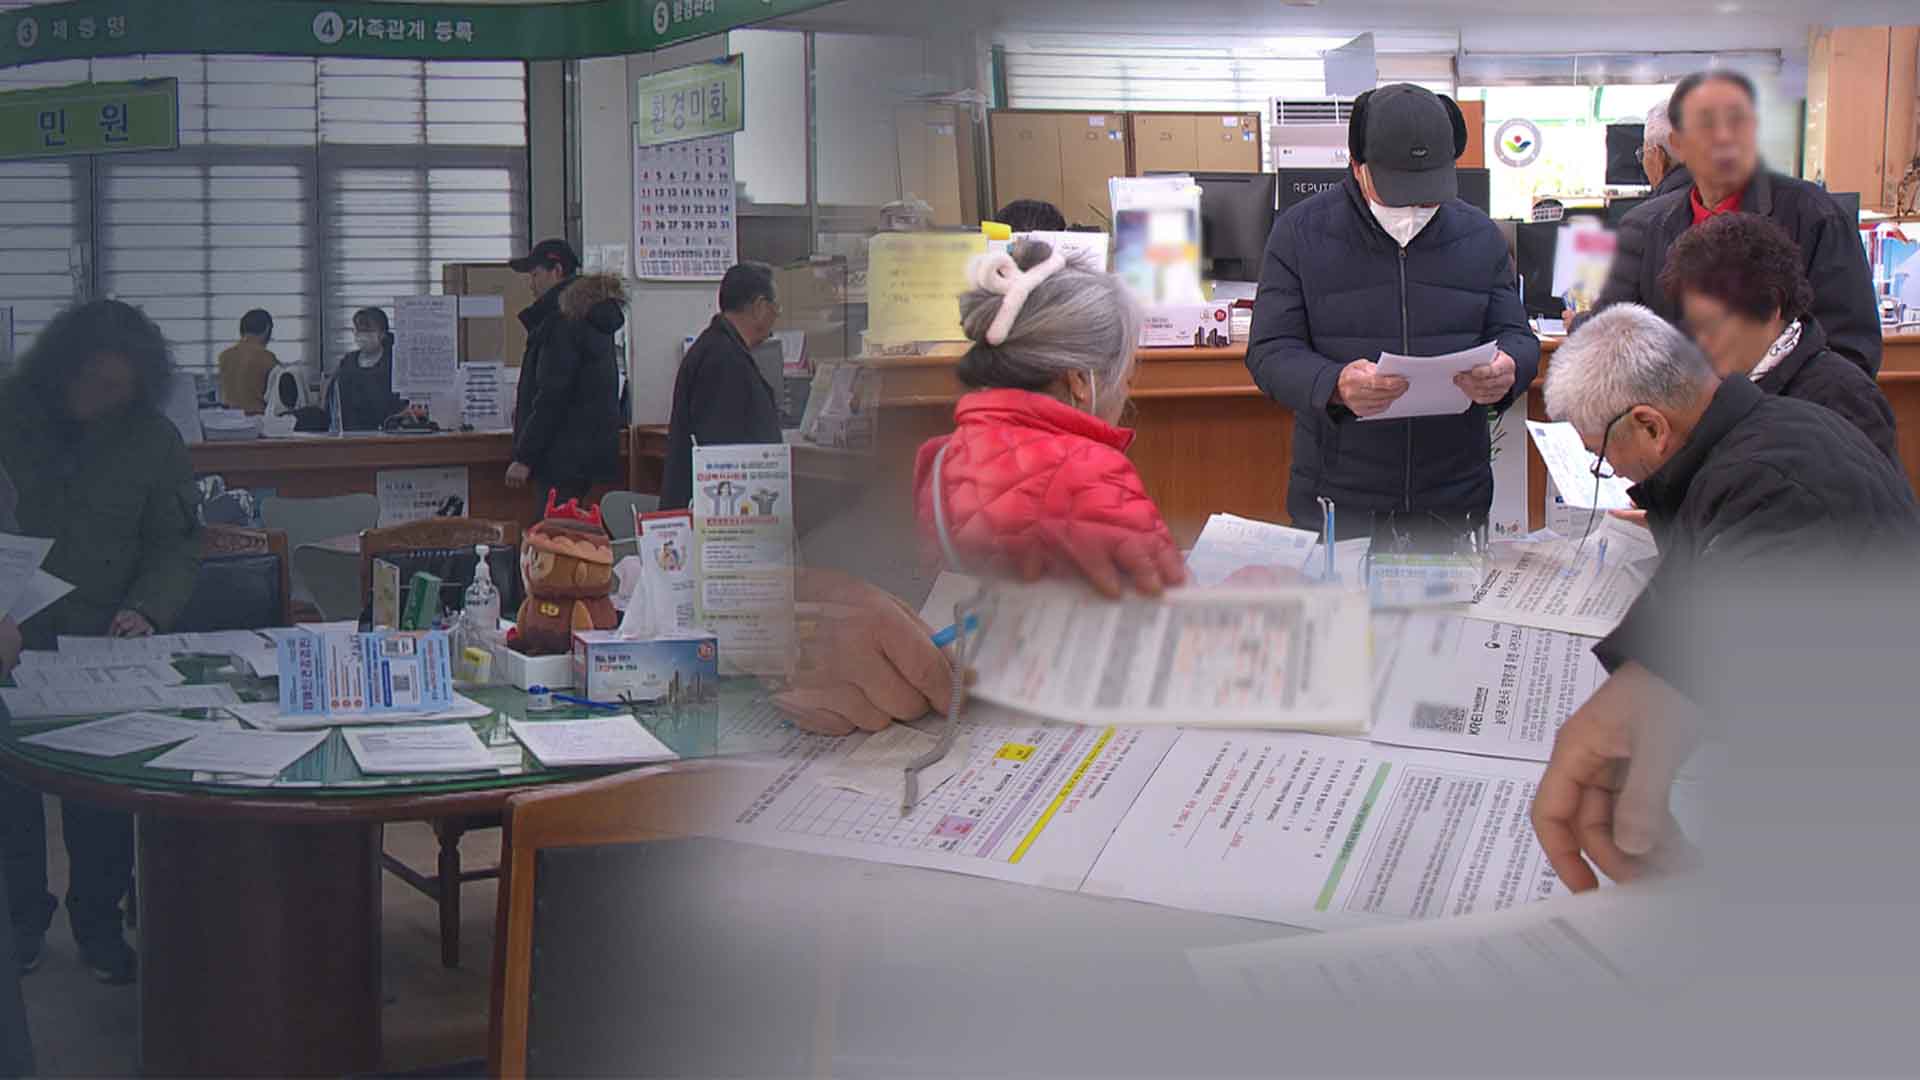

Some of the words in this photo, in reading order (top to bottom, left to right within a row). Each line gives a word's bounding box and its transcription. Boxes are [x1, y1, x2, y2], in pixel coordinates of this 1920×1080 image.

[346, 17, 425, 41] 가족관계
[435, 20, 473, 43] 등록
[650, 79, 728, 134] 환경미화
[1467, 713, 1484, 736] KREI
